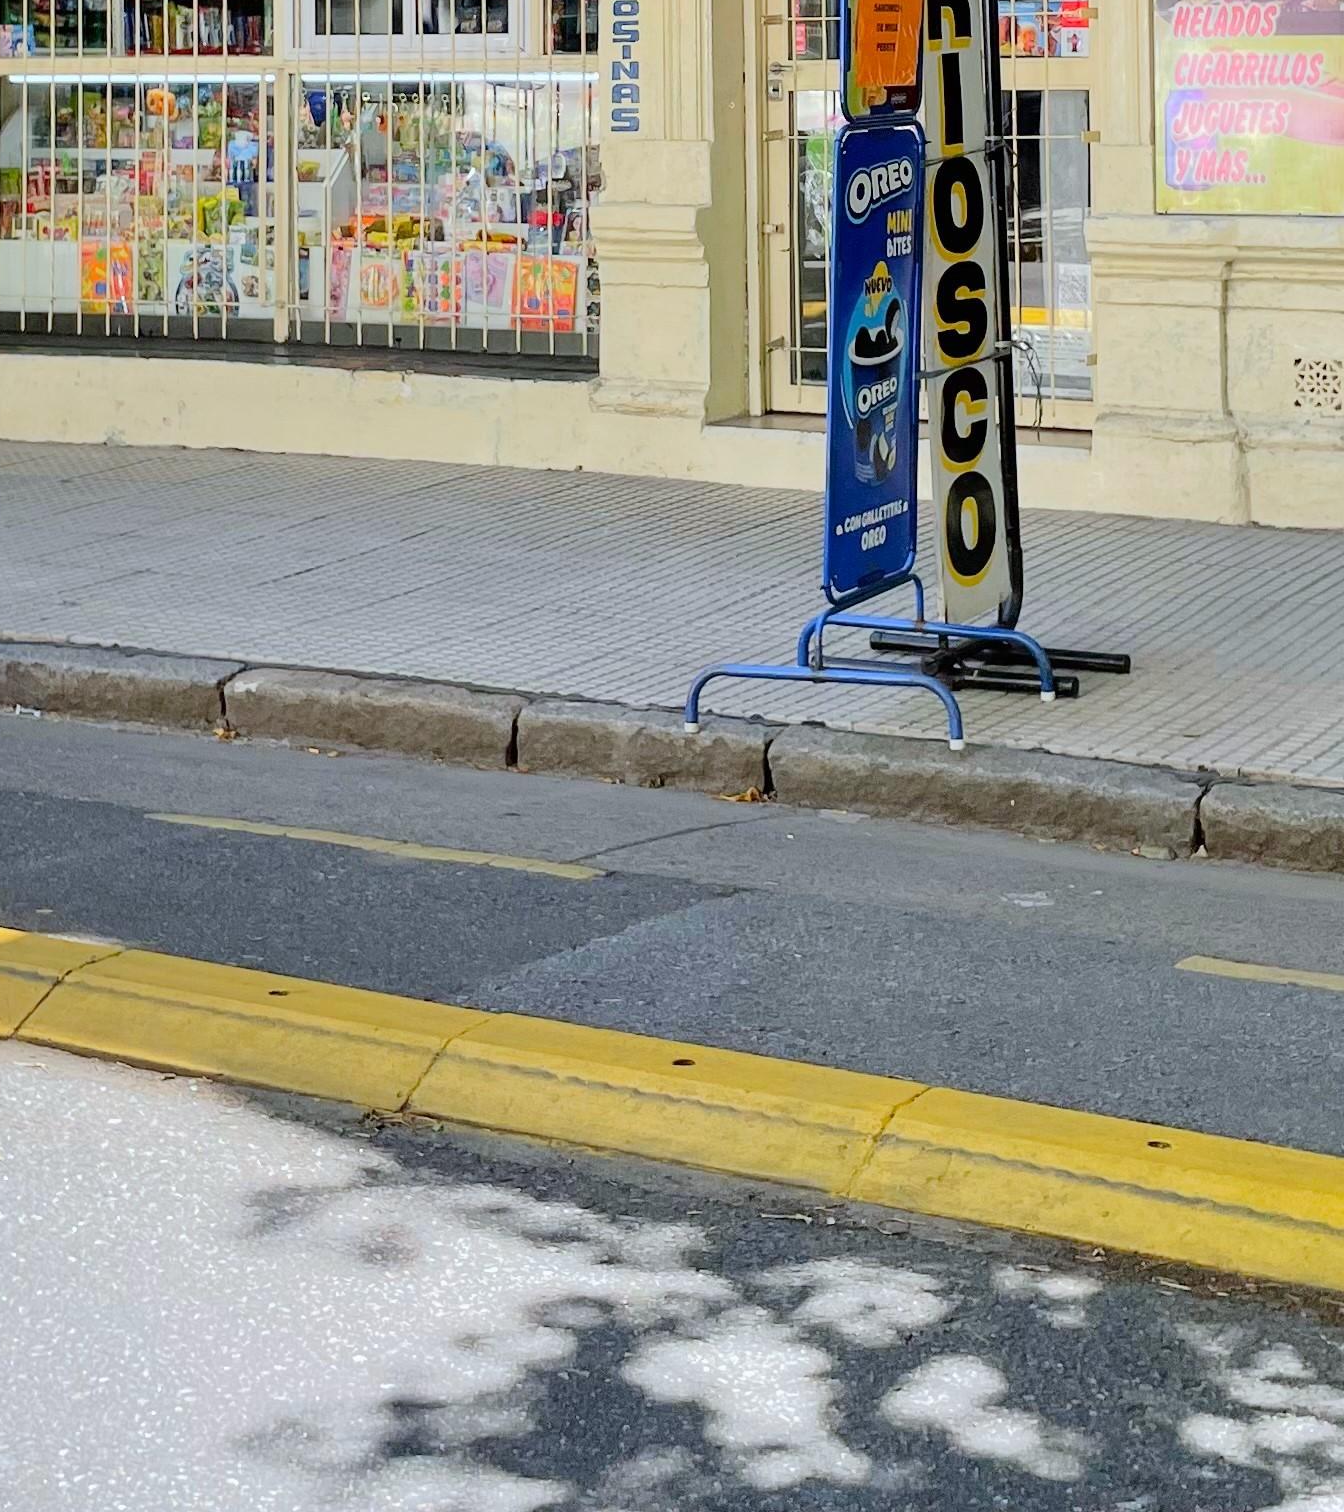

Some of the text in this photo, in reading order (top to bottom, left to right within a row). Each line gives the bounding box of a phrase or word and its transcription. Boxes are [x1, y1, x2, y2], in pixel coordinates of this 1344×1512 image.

[1174, 5, 1277, 38] HELADOS
[1174, 53, 1324, 86] CIGARRILLOS
[1173, 102, 1289, 135] JUGUETES
[1176, 150, 1191, 182] Y
[848, 160, 913, 215] OREO
[886, 209, 913, 235] MINI
[886, 235, 912, 258] BITES
[864, 277, 893, 297] NUEVO
[858, 376, 898, 414] OREO
[844, 517, 862, 533] CON
[861, 525, 887, 551] OREO
